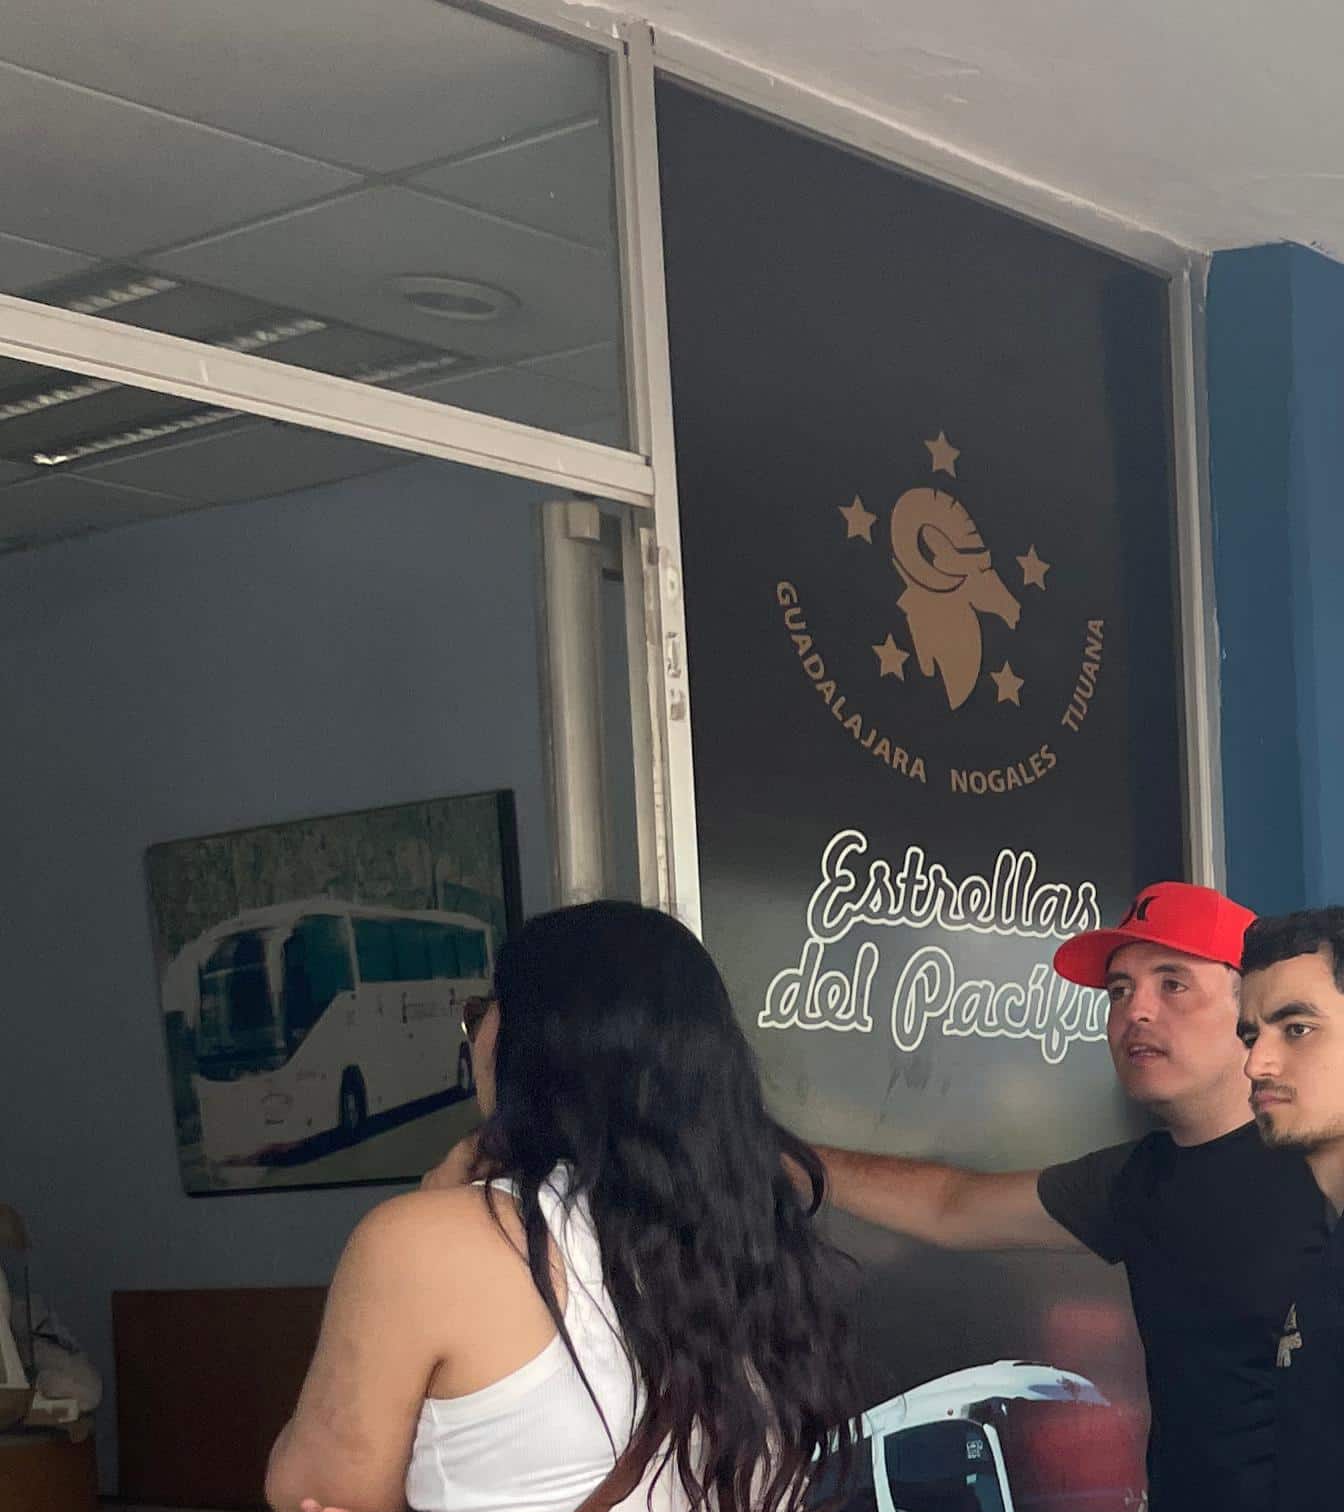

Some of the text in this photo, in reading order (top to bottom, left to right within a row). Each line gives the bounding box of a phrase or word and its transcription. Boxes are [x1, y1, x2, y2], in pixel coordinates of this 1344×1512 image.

[776, 580, 1105, 794] GUADALAJARA NOGALES TIJUANA
[806, 829, 1101, 943] Estrellas
[758, 937, 880, 1032] del
